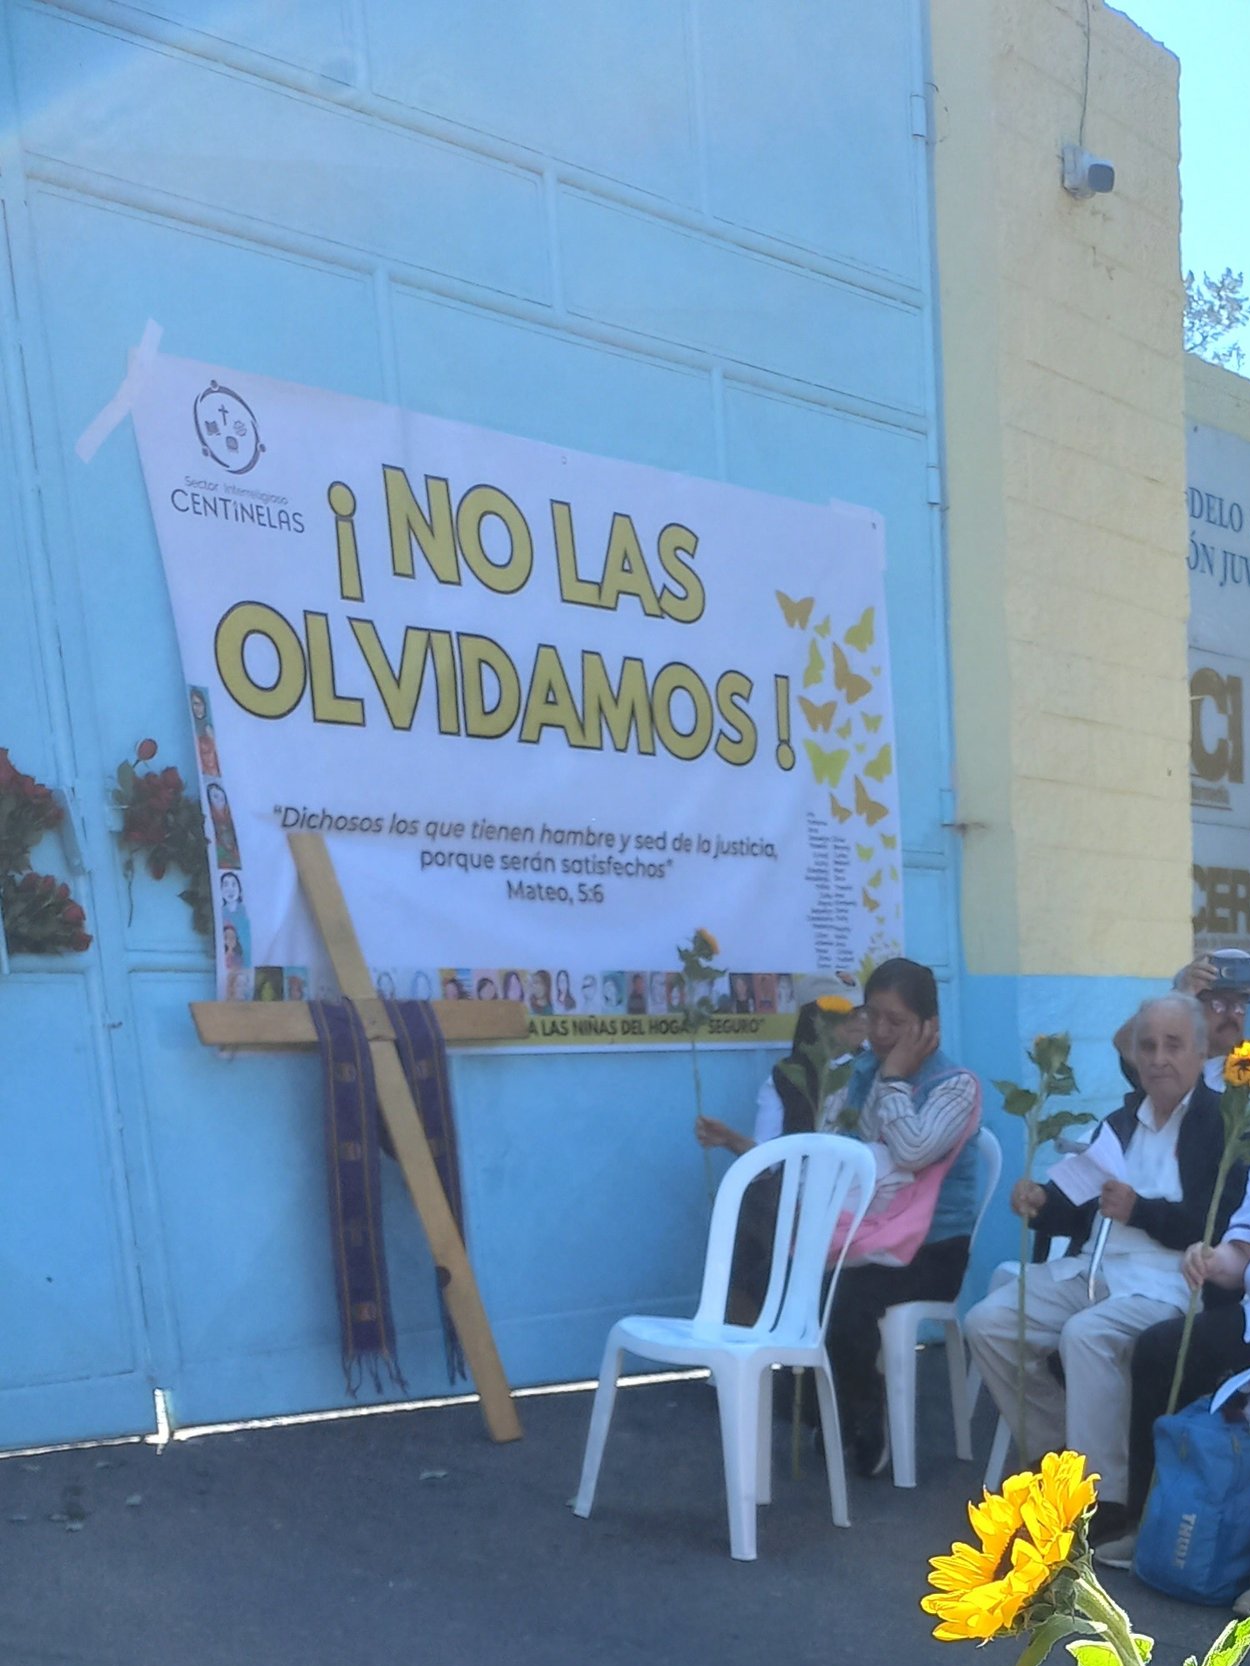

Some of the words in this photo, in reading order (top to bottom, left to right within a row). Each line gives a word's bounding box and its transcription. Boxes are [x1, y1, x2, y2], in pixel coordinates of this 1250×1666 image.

[1186, 486, 1243, 533] DELO
[382, 464, 534, 594] NO
[550, 500, 706, 624] LAS
[214, 601, 758, 767] OLVIDAMOS
[389, 812, 419, 835] los
[425, 819, 465, 842] que
[471, 818, 534, 843] tienen
[540, 822, 616, 848] hambre
[619, 833, 632, 853] y
[634, 831, 667, 850] sed
[671, 833, 692, 851] de
[697, 833, 711, 851] la
[713, 834, 778, 861] justicia,
[420, 850, 495, 873] porque
[500, 853, 556, 875] serán
[505, 879, 574, 905] Mateo,
[578, 883, 604, 903] 5:6
[542, 1020, 569, 1037] LAS
[572, 1014, 618, 1037] NIÑAS
[621, 1018, 645, 1036] DEL
[650, 1018, 698, 1037] HOGA
